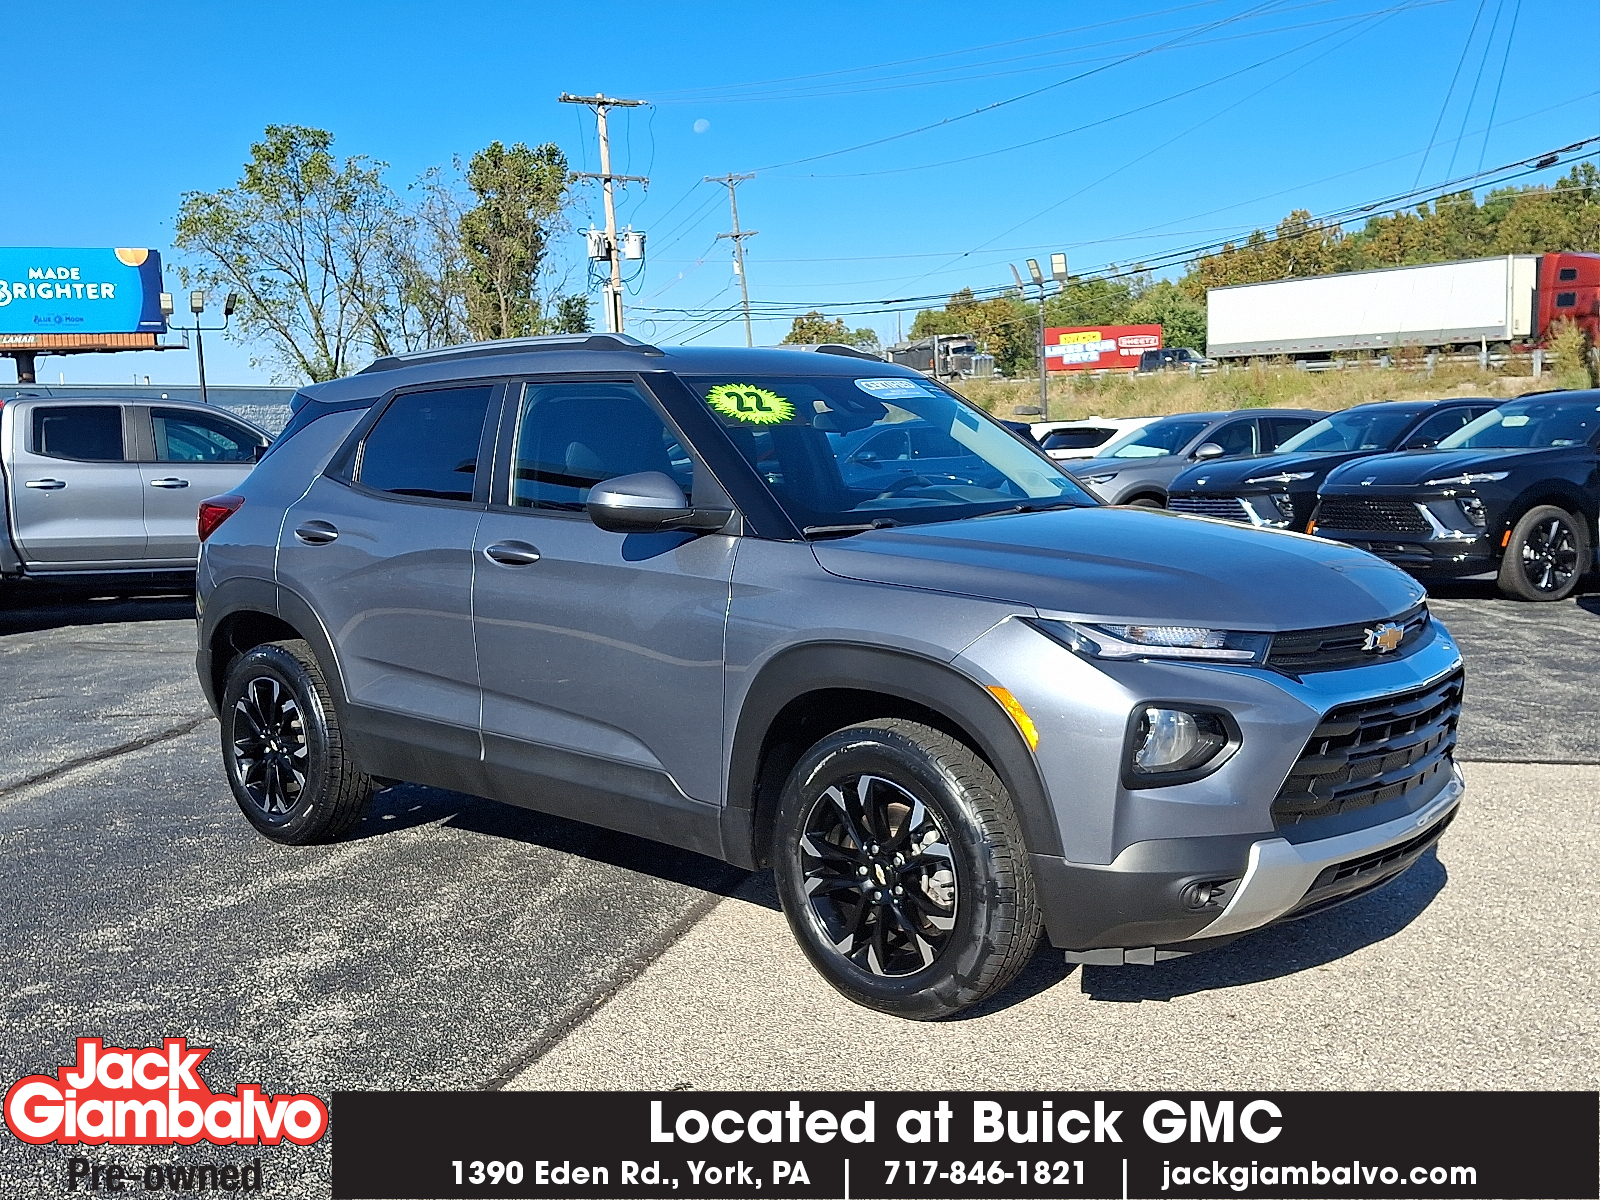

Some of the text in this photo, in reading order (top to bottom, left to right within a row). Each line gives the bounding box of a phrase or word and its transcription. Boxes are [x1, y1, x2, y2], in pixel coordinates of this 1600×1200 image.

[28, 267, 81, 280] MADE
[1121, 338, 1156, 346] SHEETZ
[725, 391, 772, 412] 22
